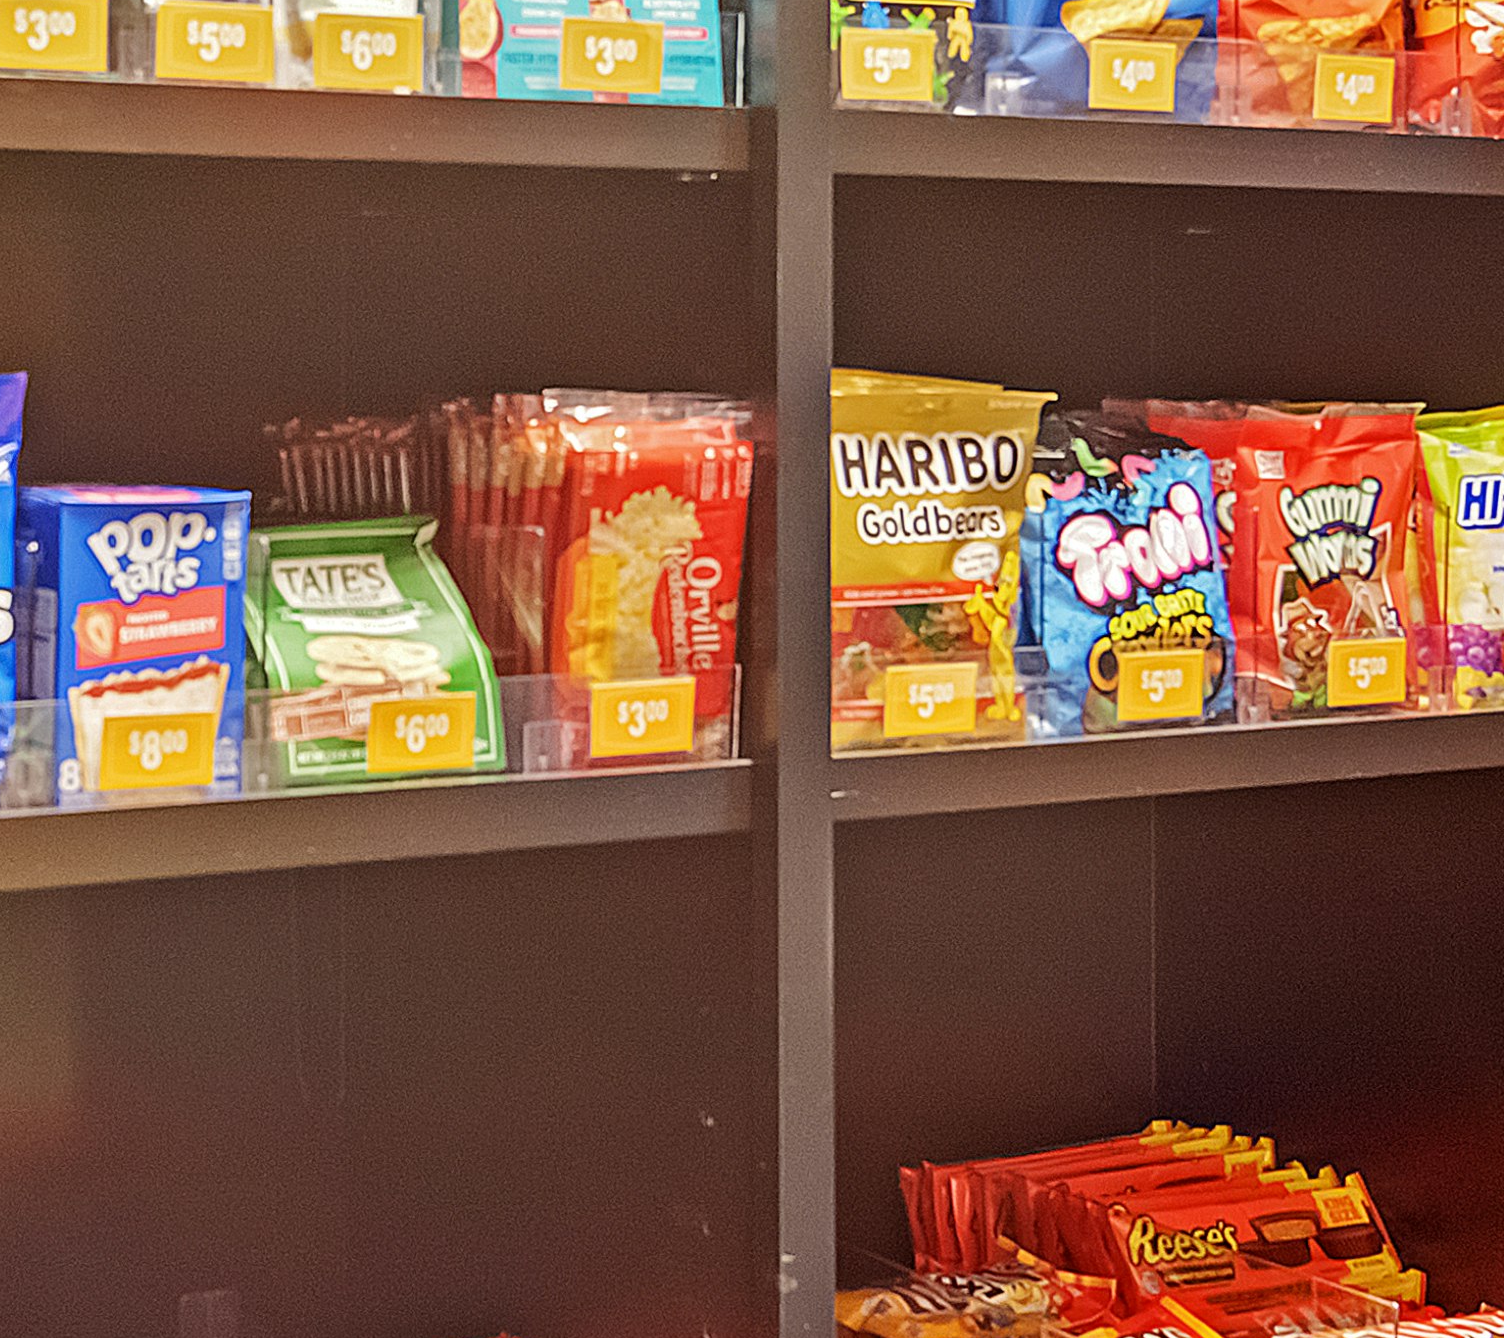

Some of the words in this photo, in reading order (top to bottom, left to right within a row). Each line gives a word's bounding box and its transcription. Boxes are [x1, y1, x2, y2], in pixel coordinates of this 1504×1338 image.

[835, 431, 1022, 495] HARIBO
[860, 505, 1002, 541] Goldbears
[276, 563, 388, 597] TATE'S
[686, 555, 723, 670] Orville
[1128, 1213, 1240, 1266] Reese's
